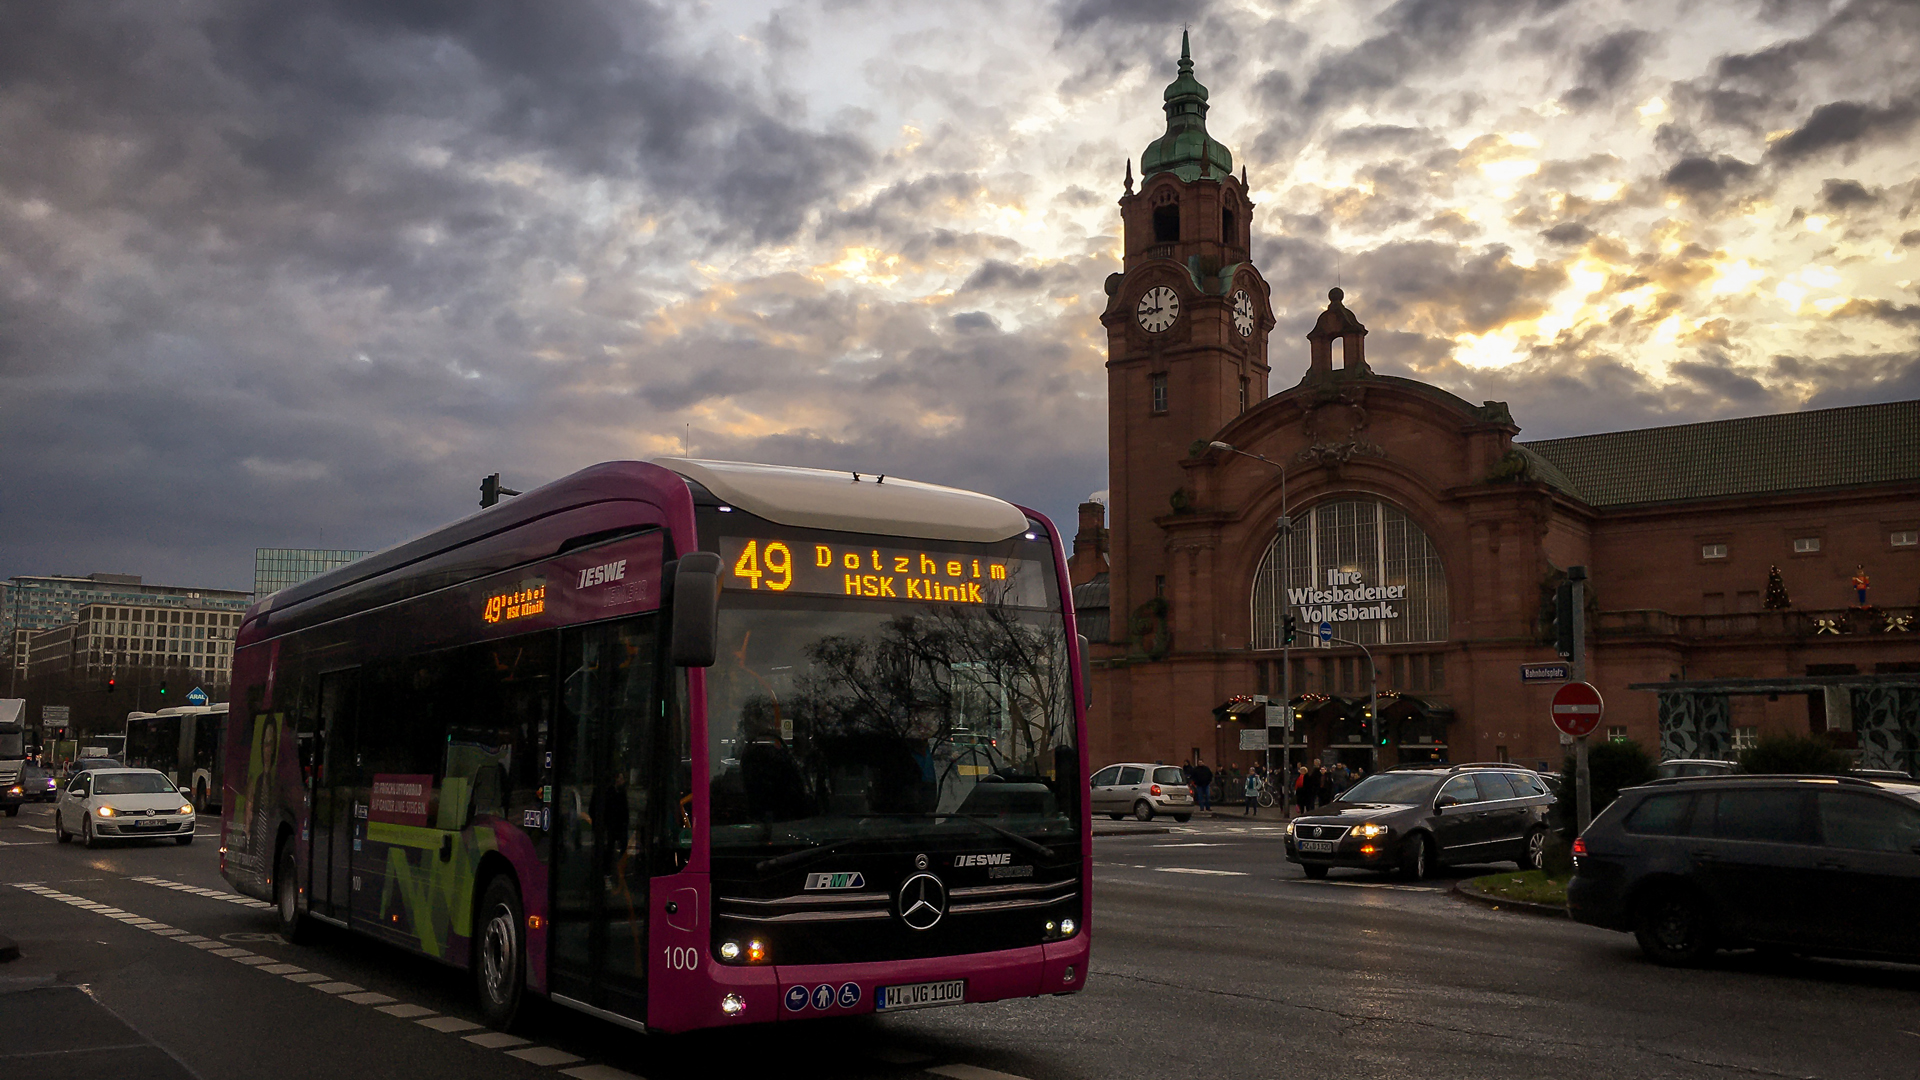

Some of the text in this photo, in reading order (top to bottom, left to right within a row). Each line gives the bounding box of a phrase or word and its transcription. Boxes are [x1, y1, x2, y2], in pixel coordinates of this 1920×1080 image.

[735, 541, 791, 590] 49
[816, 545, 1006, 579] Dotzheim
[845, 574, 897, 597] HSK
[1327, 568, 1362, 586] Ihre
[1287, 583, 1406, 605] Wiesbadener
[484, 596, 501, 624] 49
[1300, 601, 1399, 623] Volksbank.
[1525, 667, 1564, 678] Bahnhofsplatz
[815, 872, 860, 889] RMV
[664, 945, 699, 971] 100
[887, 982, 961, 1005] WI VG 1100
